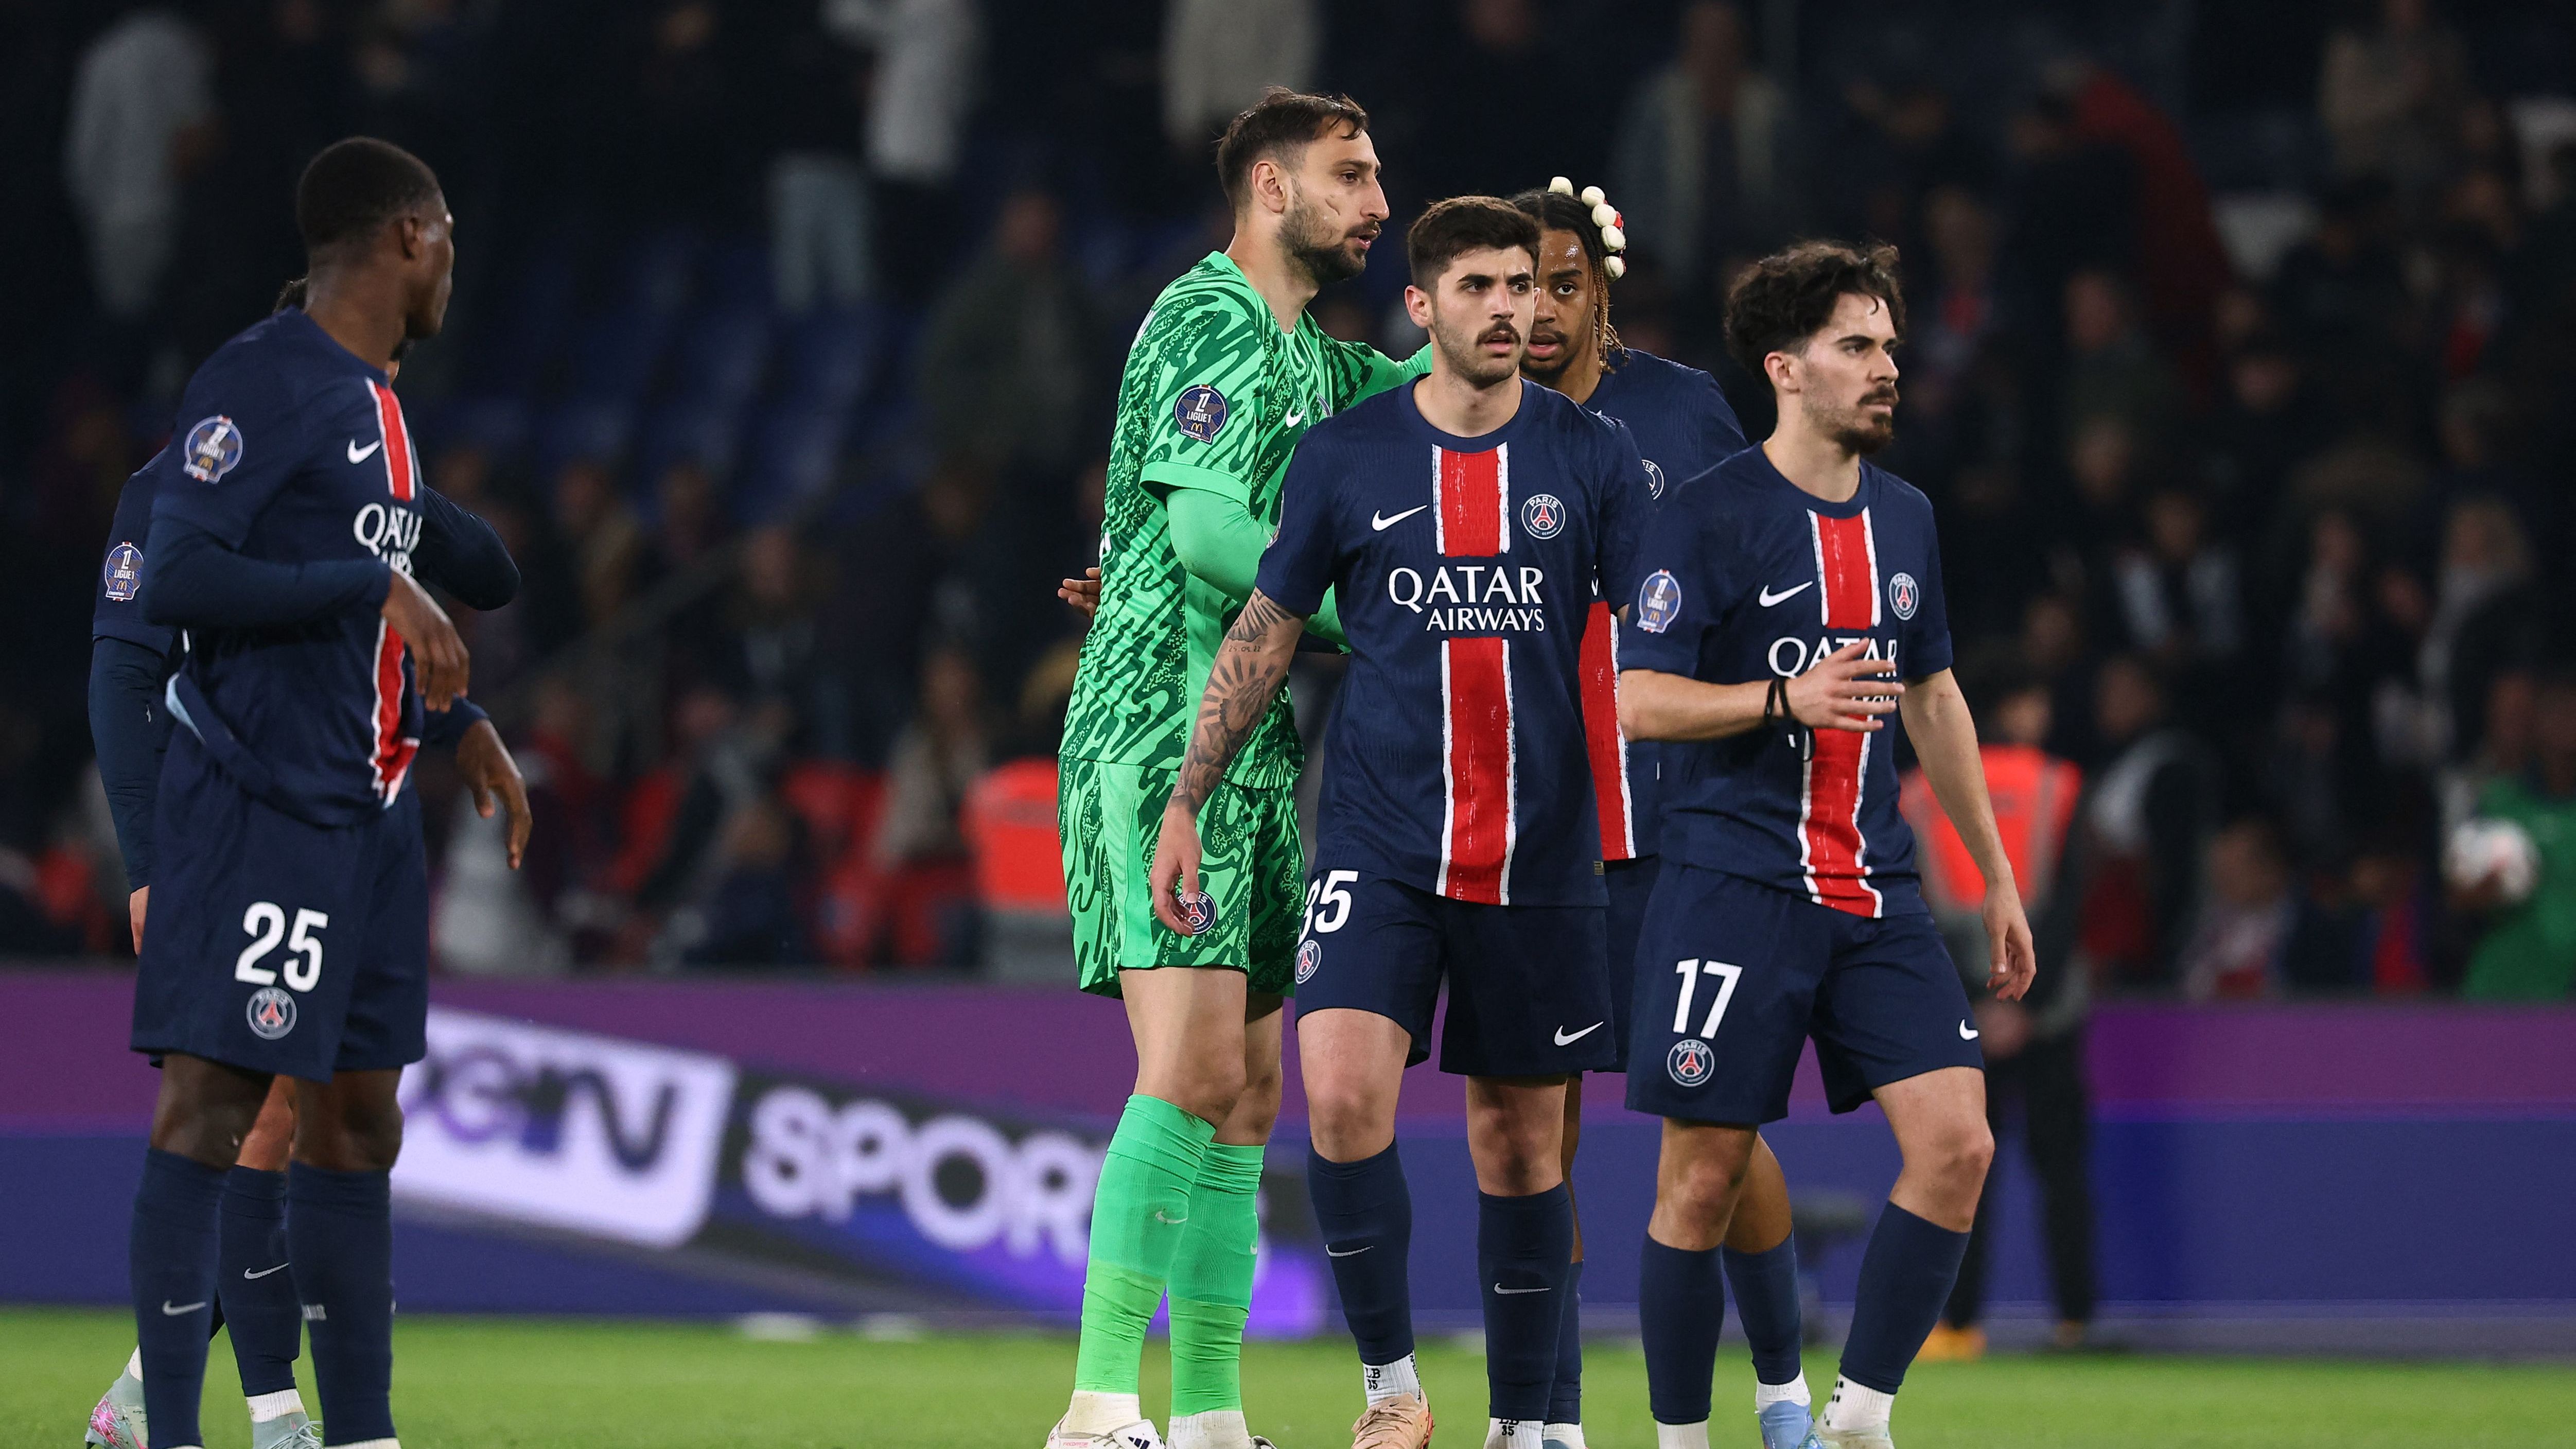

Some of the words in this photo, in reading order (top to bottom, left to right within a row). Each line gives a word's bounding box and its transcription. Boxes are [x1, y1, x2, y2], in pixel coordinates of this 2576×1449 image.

[1529, 496, 1558, 508] PARIS
[1389, 566, 1544, 614] QATAR
[1426, 608, 1545, 632] AIRWAYS
[1179, 894, 1208, 904] PIS
[235, 901, 329, 993] 25
[1673, 958, 1743, 1040] 17
[1365, 1367, 1381, 1379] LB
[1501, 1424, 1515, 1436] 35
